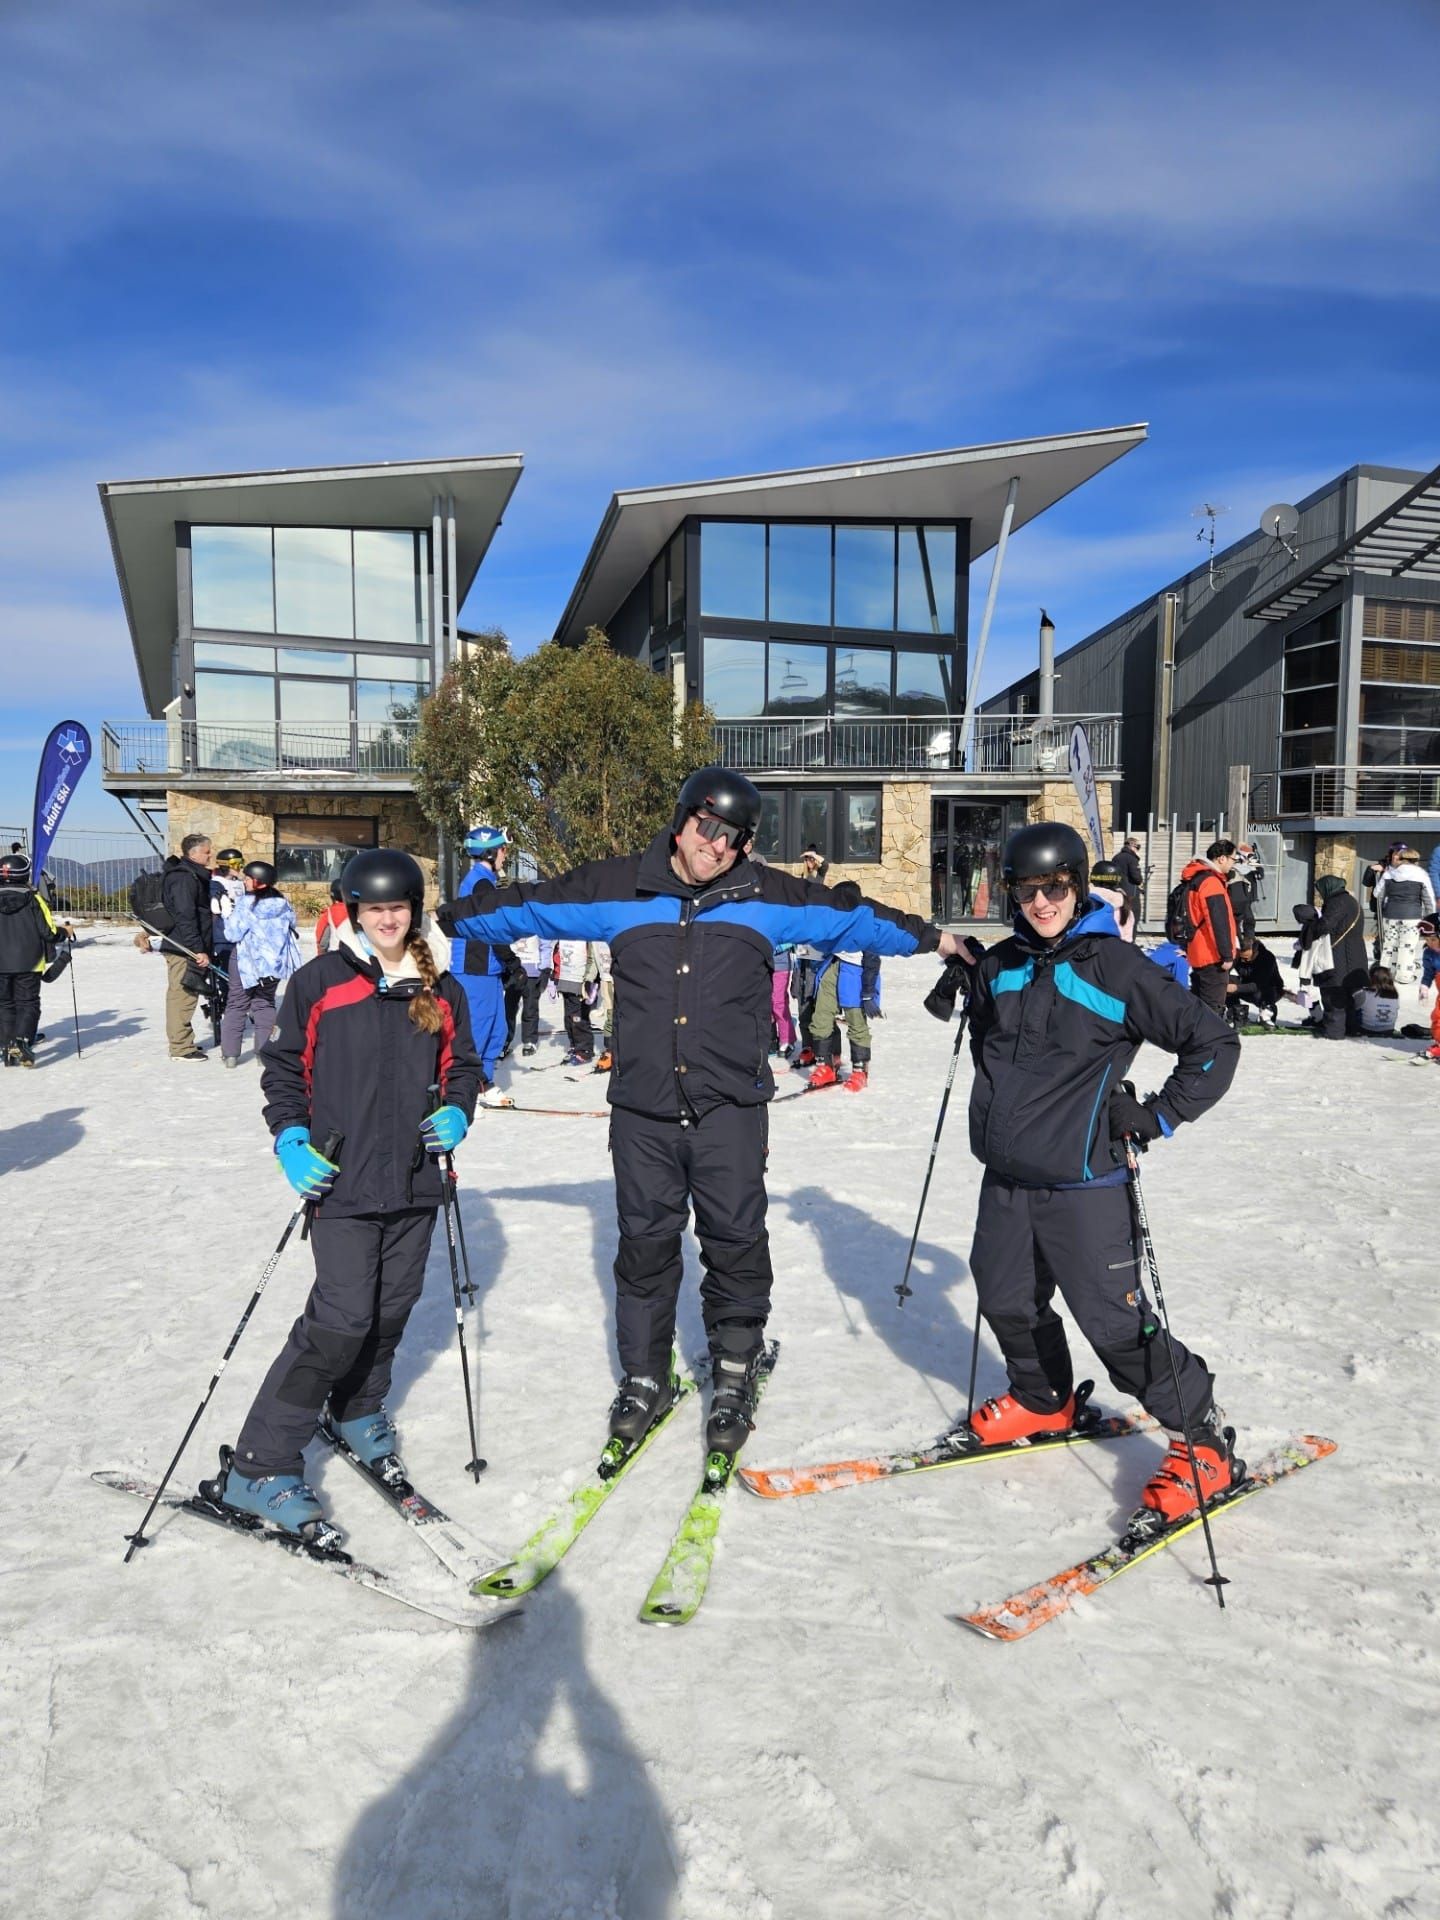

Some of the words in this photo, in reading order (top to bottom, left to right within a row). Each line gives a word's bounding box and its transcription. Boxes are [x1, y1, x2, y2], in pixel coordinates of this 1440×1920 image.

[42, 803, 61, 836] Adult
[57, 783, 71, 804] Ski
[1248, 823, 1280, 832] NOWMASS
